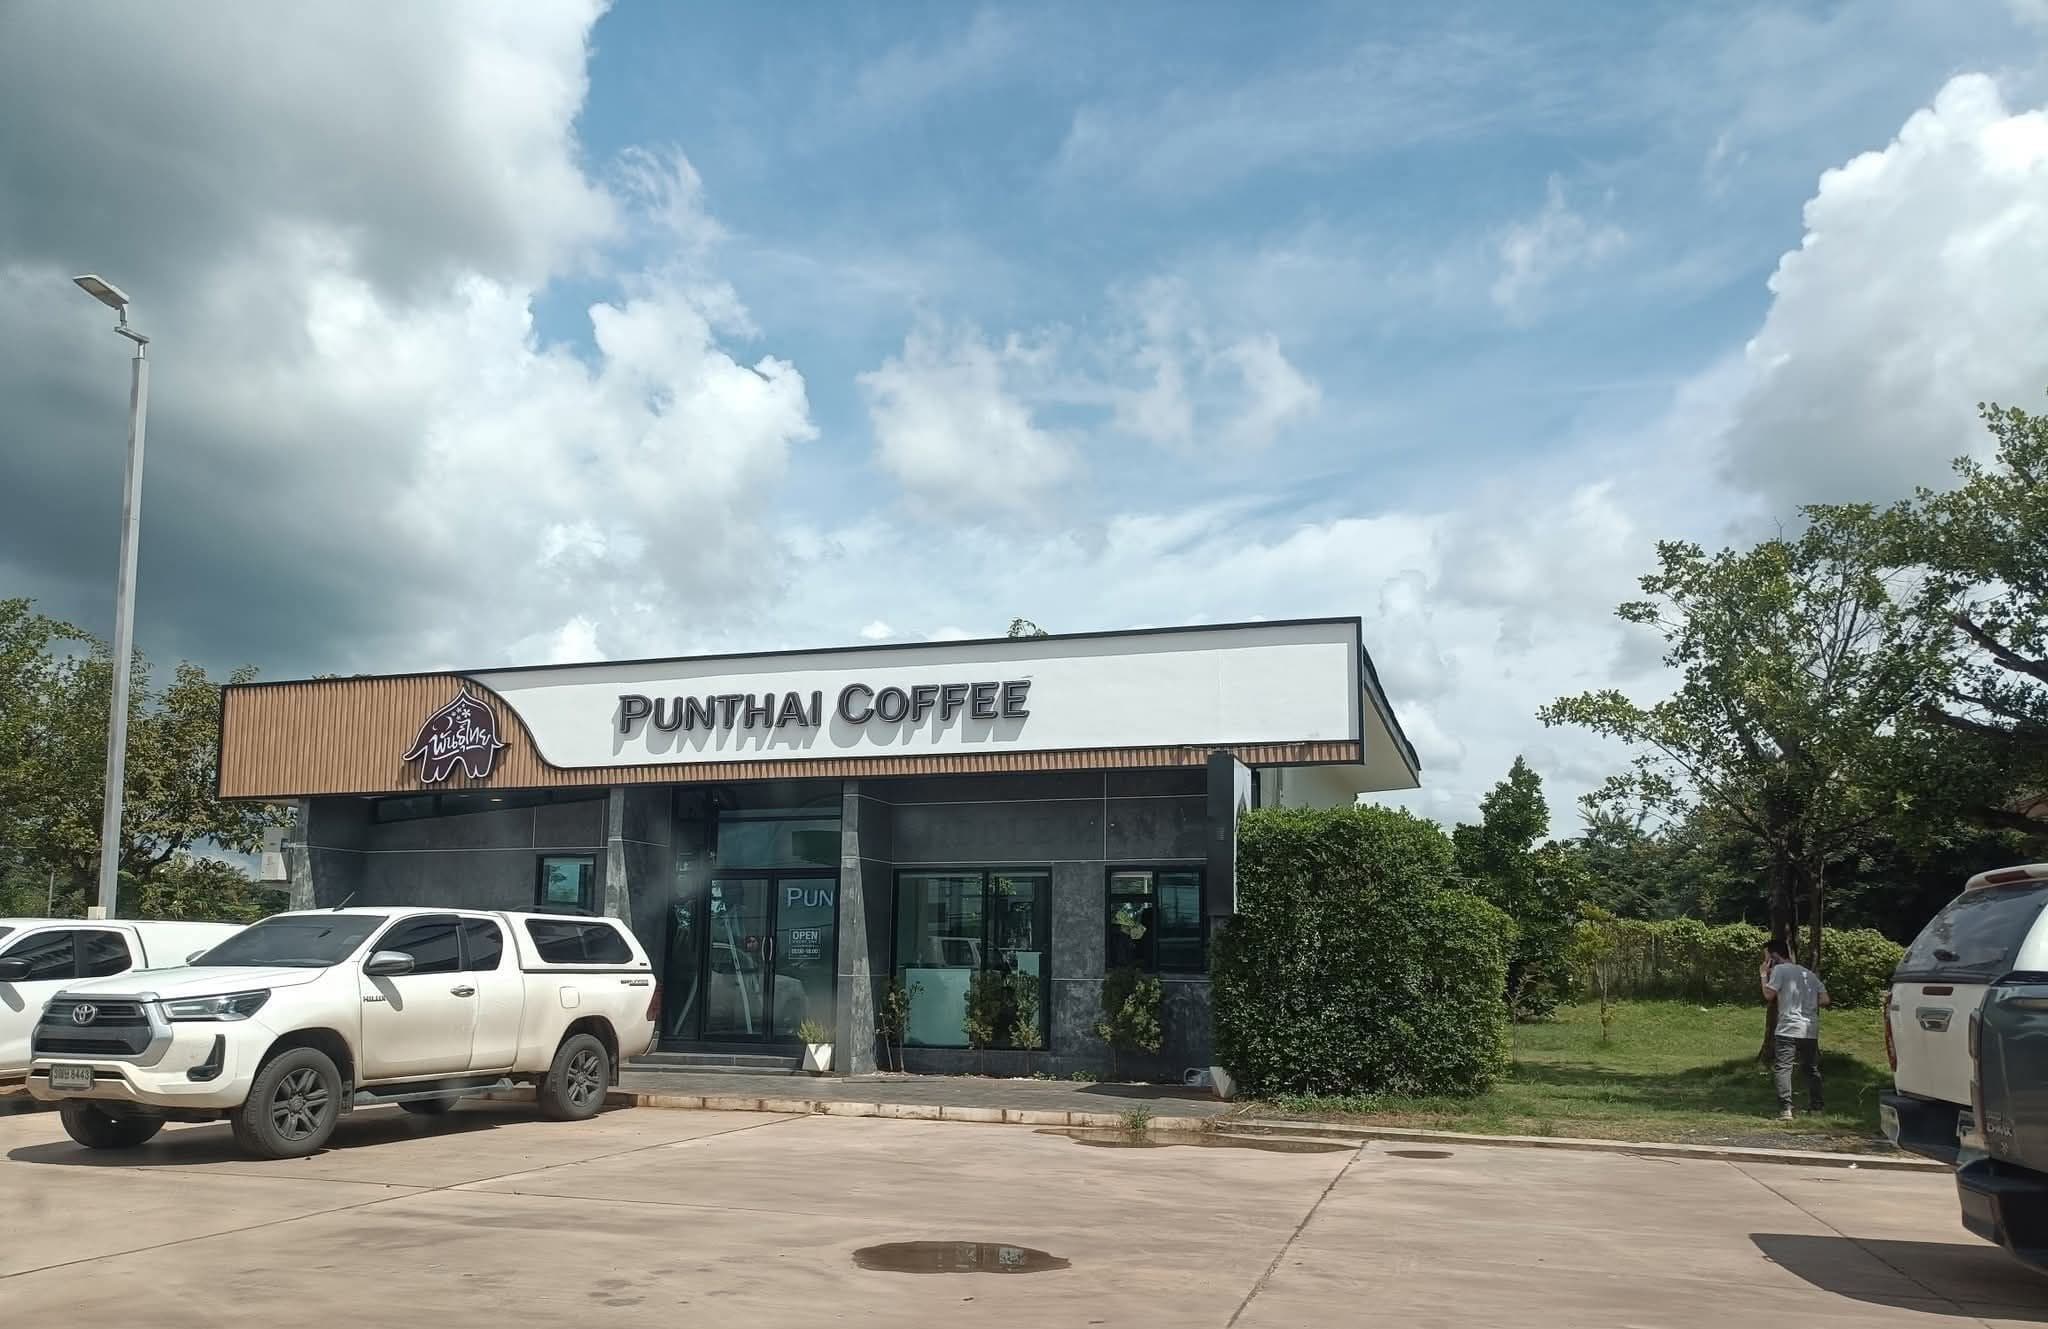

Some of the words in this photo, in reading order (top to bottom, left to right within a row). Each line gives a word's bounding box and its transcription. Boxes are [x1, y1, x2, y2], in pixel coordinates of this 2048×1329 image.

[618, 690, 823, 734] PUNTHAI
[837, 679, 1031, 726] COFFEE
[428, 718, 492, 756] พันธุ์ไทย
[787, 888, 833, 907] PUN
[792, 930, 818, 940] OPEN
